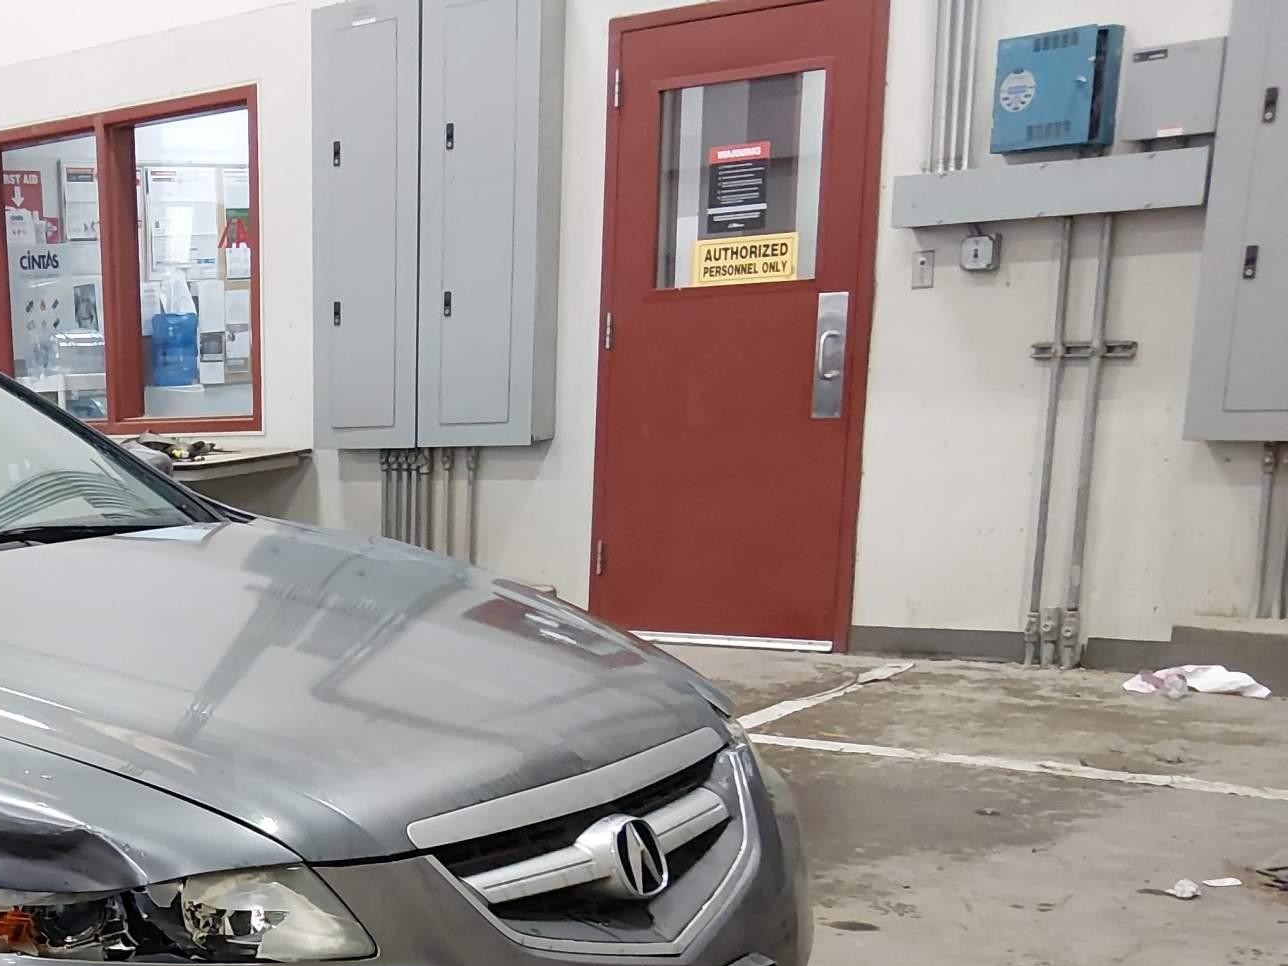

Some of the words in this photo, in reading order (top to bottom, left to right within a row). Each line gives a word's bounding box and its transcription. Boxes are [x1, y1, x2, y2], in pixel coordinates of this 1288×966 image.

[3, 174, 21, 184] RST
[23, 174, 38, 184] AID
[19, 250, 60, 271] CINTAS
[704, 242, 789, 262] AUTHORIZED
[703, 263, 758, 278] PERSONNEL
[761, 260, 788, 274] ONLY
